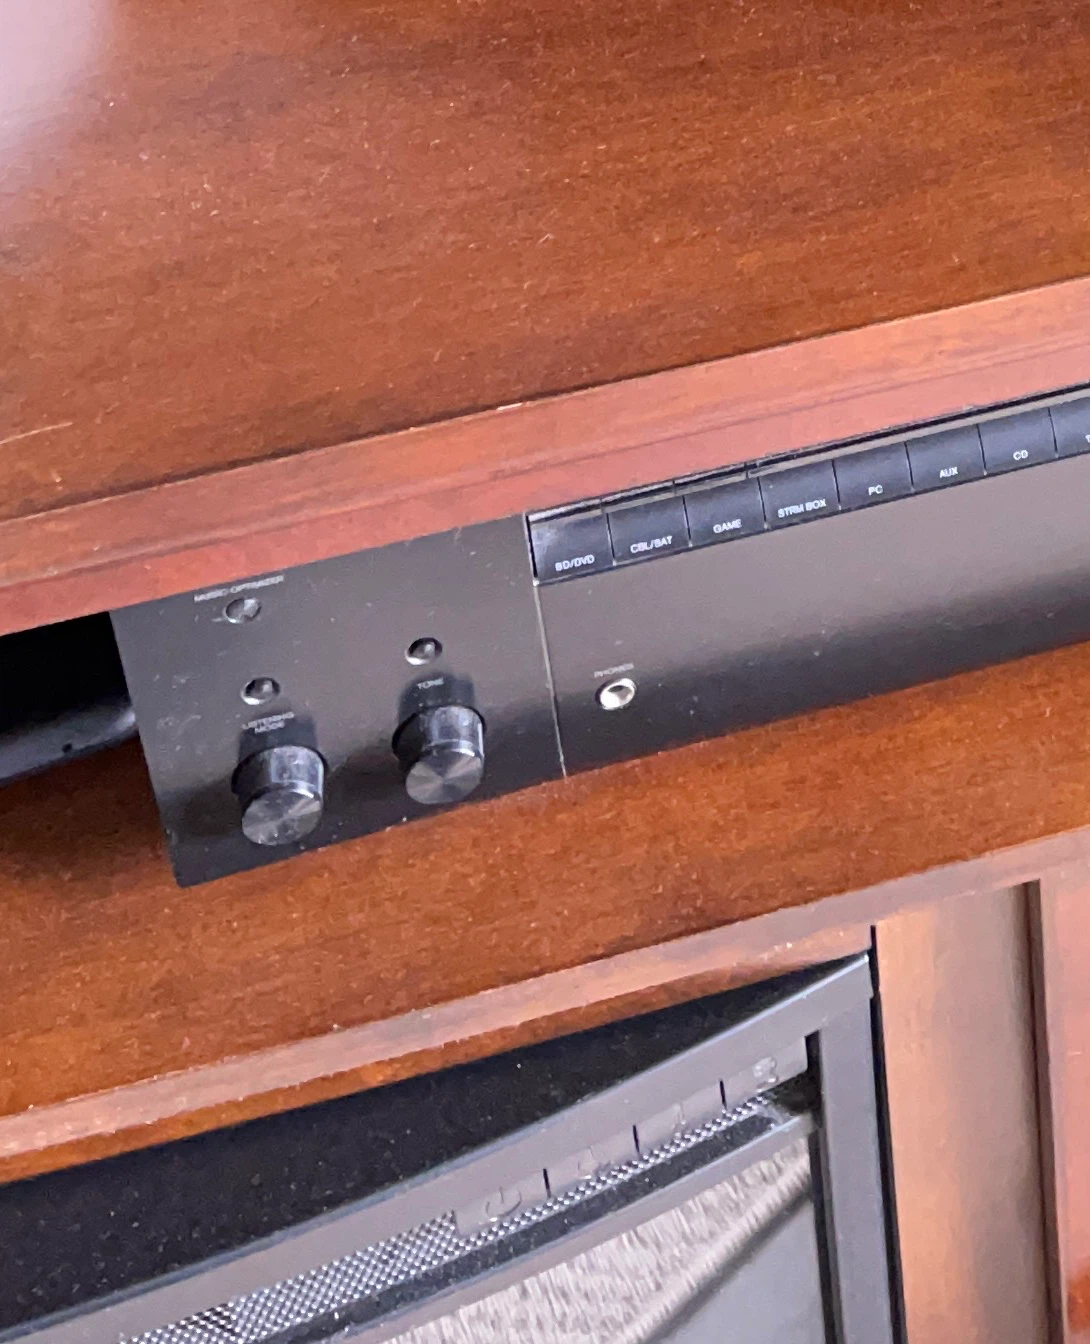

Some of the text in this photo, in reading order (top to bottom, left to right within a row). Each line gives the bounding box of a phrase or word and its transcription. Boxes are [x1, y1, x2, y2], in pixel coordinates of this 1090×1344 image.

[1013, 449, 1029, 461] CD
[939, 466, 958, 479] AUX
[868, 484, 884, 496] PC
[805, 498, 827, 512] BOX
[713, 518, 742, 534] GAME
[630, 535, 673, 554] CBL/SAT
[555, 554, 595, 572] BD/DVD
